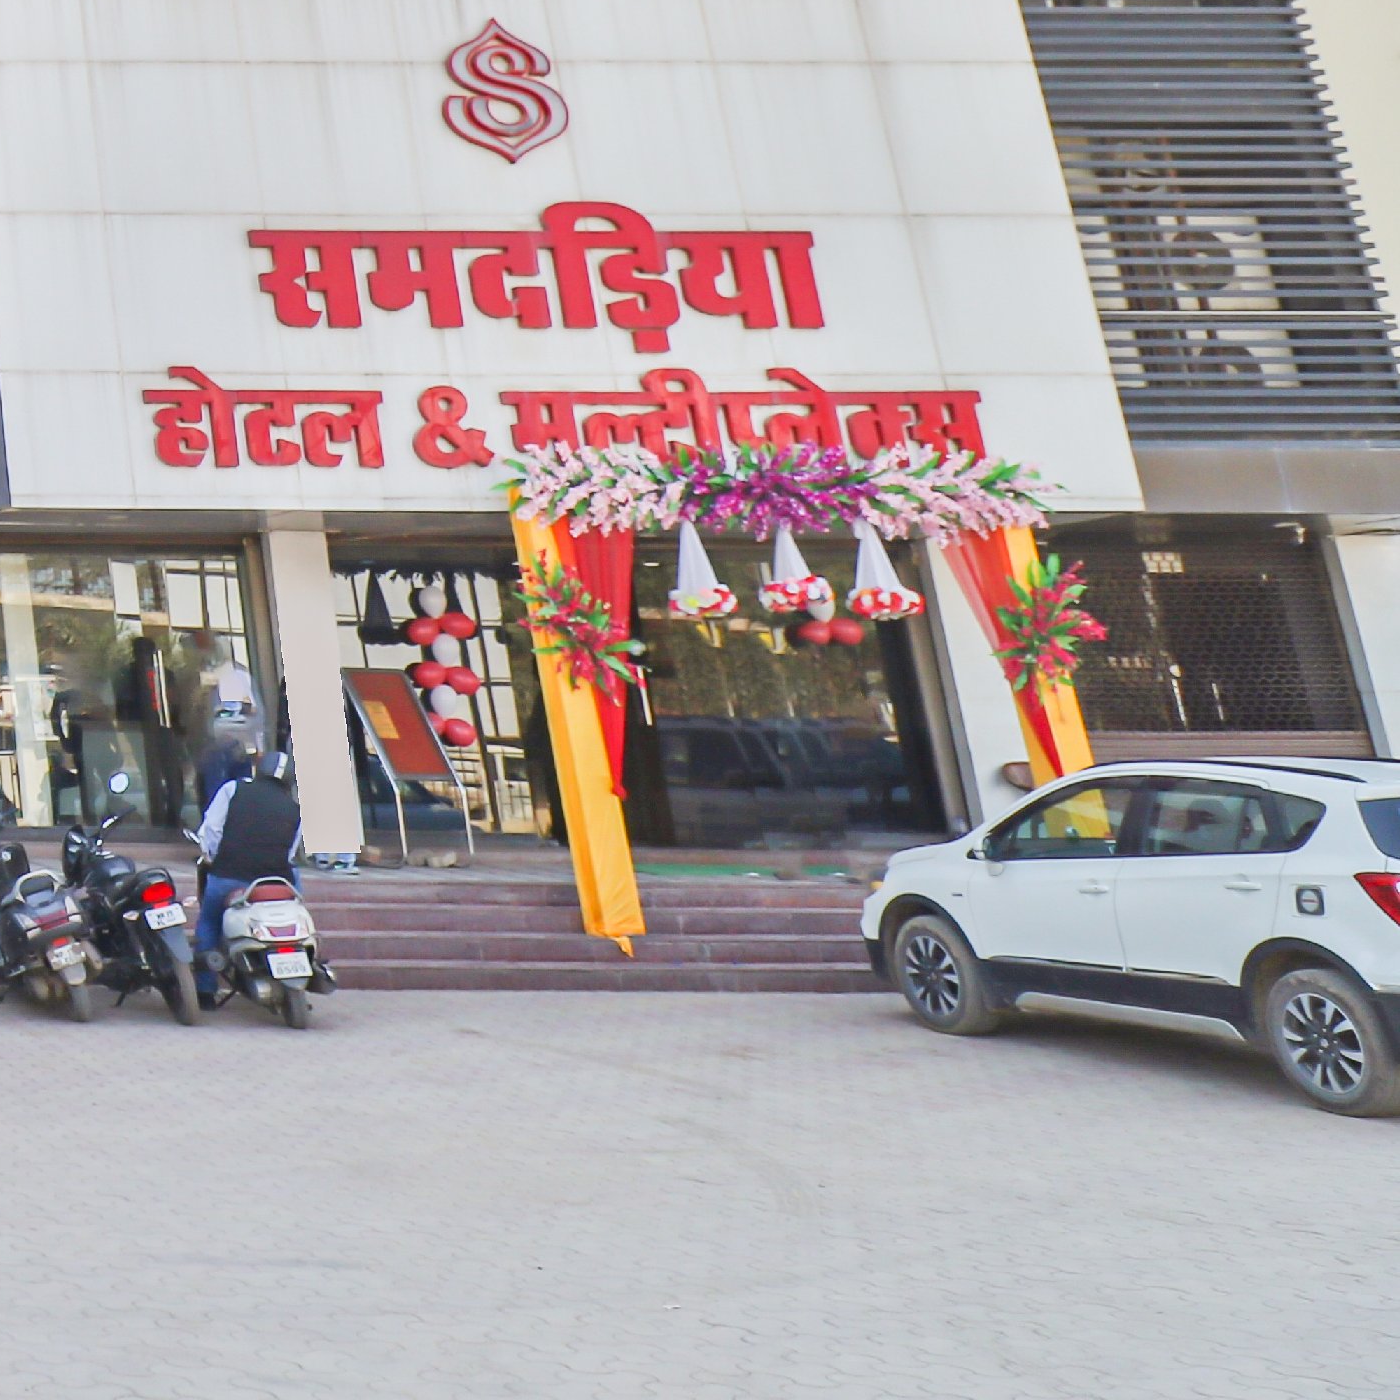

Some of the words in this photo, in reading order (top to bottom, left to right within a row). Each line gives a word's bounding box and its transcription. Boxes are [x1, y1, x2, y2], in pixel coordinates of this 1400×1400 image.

[247, 200, 826, 354] समदड़िया
[142, 366, 384, 468] होटल
[412, 385, 495, 469] &
